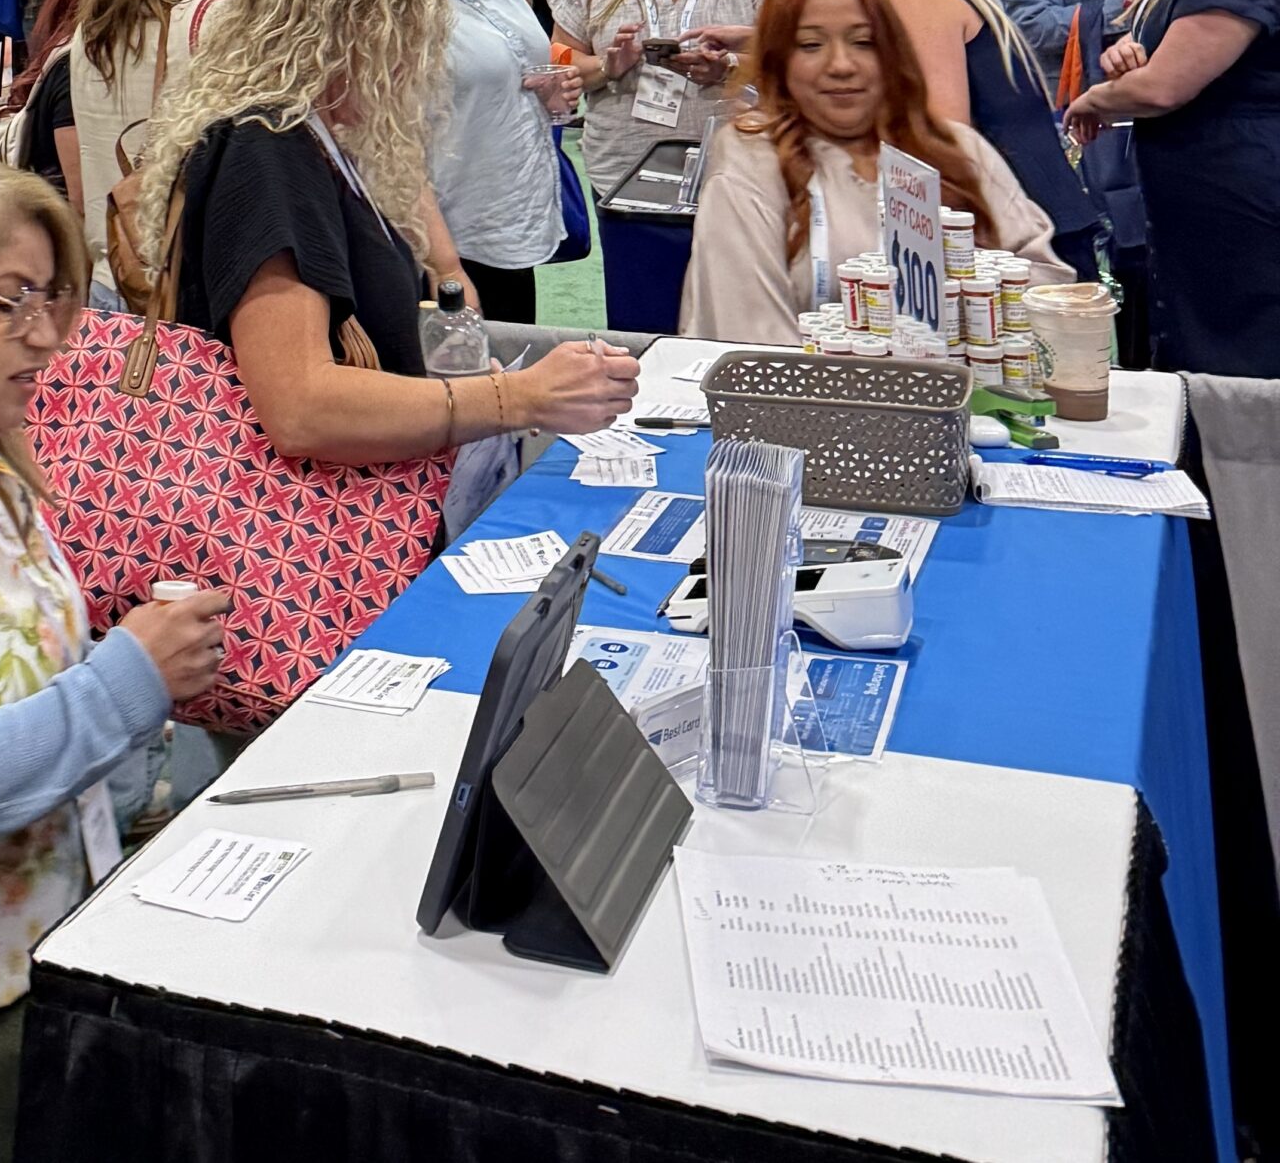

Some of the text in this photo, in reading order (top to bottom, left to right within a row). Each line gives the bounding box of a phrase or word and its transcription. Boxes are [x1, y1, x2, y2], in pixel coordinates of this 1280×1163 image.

[891, 229, 939, 333] $100
[662, 716, 700, 742] Best Card
